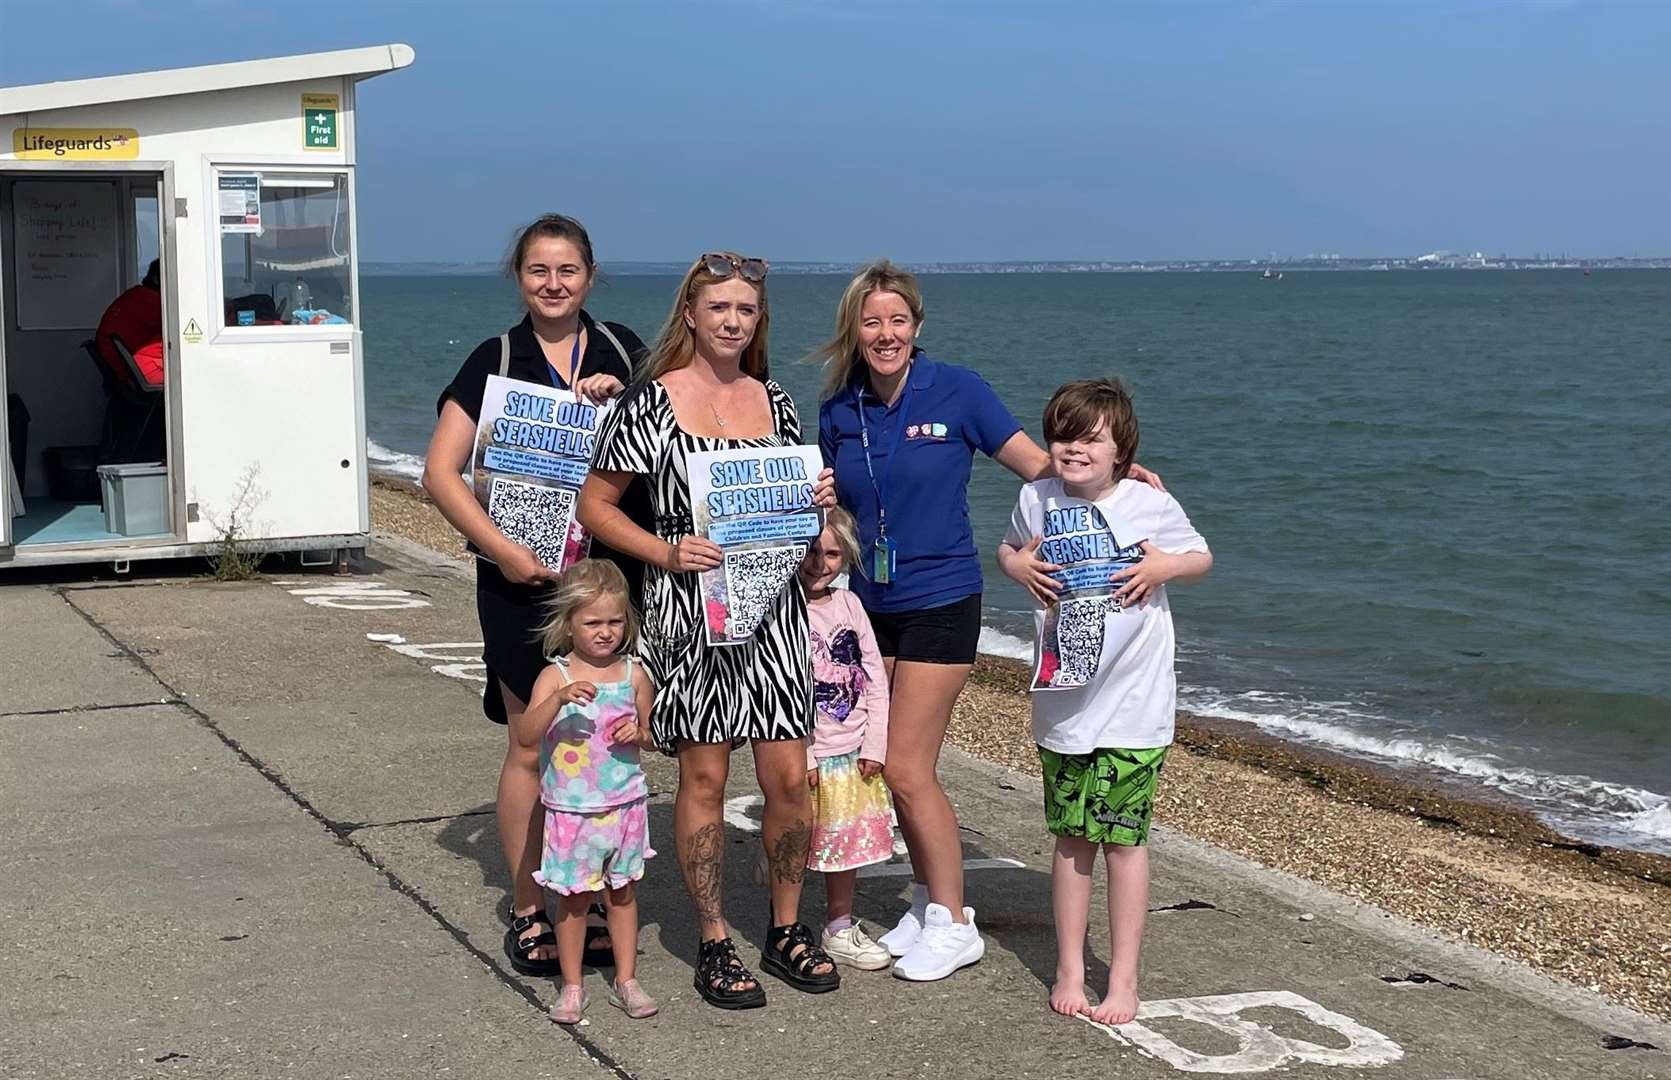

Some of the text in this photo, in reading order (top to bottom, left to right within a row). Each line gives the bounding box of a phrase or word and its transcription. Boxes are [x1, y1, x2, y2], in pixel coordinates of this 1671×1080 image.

[310, 125, 331, 134] First
[314, 136, 328, 144] aid
[23, 135, 112, 156] Lifeguards
[504, 391, 598, 431] SAVE OUR
[492, 418, 595, 458] SEASHELLS
[498, 463, 523, 473] Children
[536, 469, 560, 478] Families
[503, 458, 530, 468] proposed
[548, 458, 562, 466] have
[710, 456, 808, 488] SAVE OUR
[707, 483, 815, 518] SEASHELLS
[1043, 505, 1088, 537] SAVE
